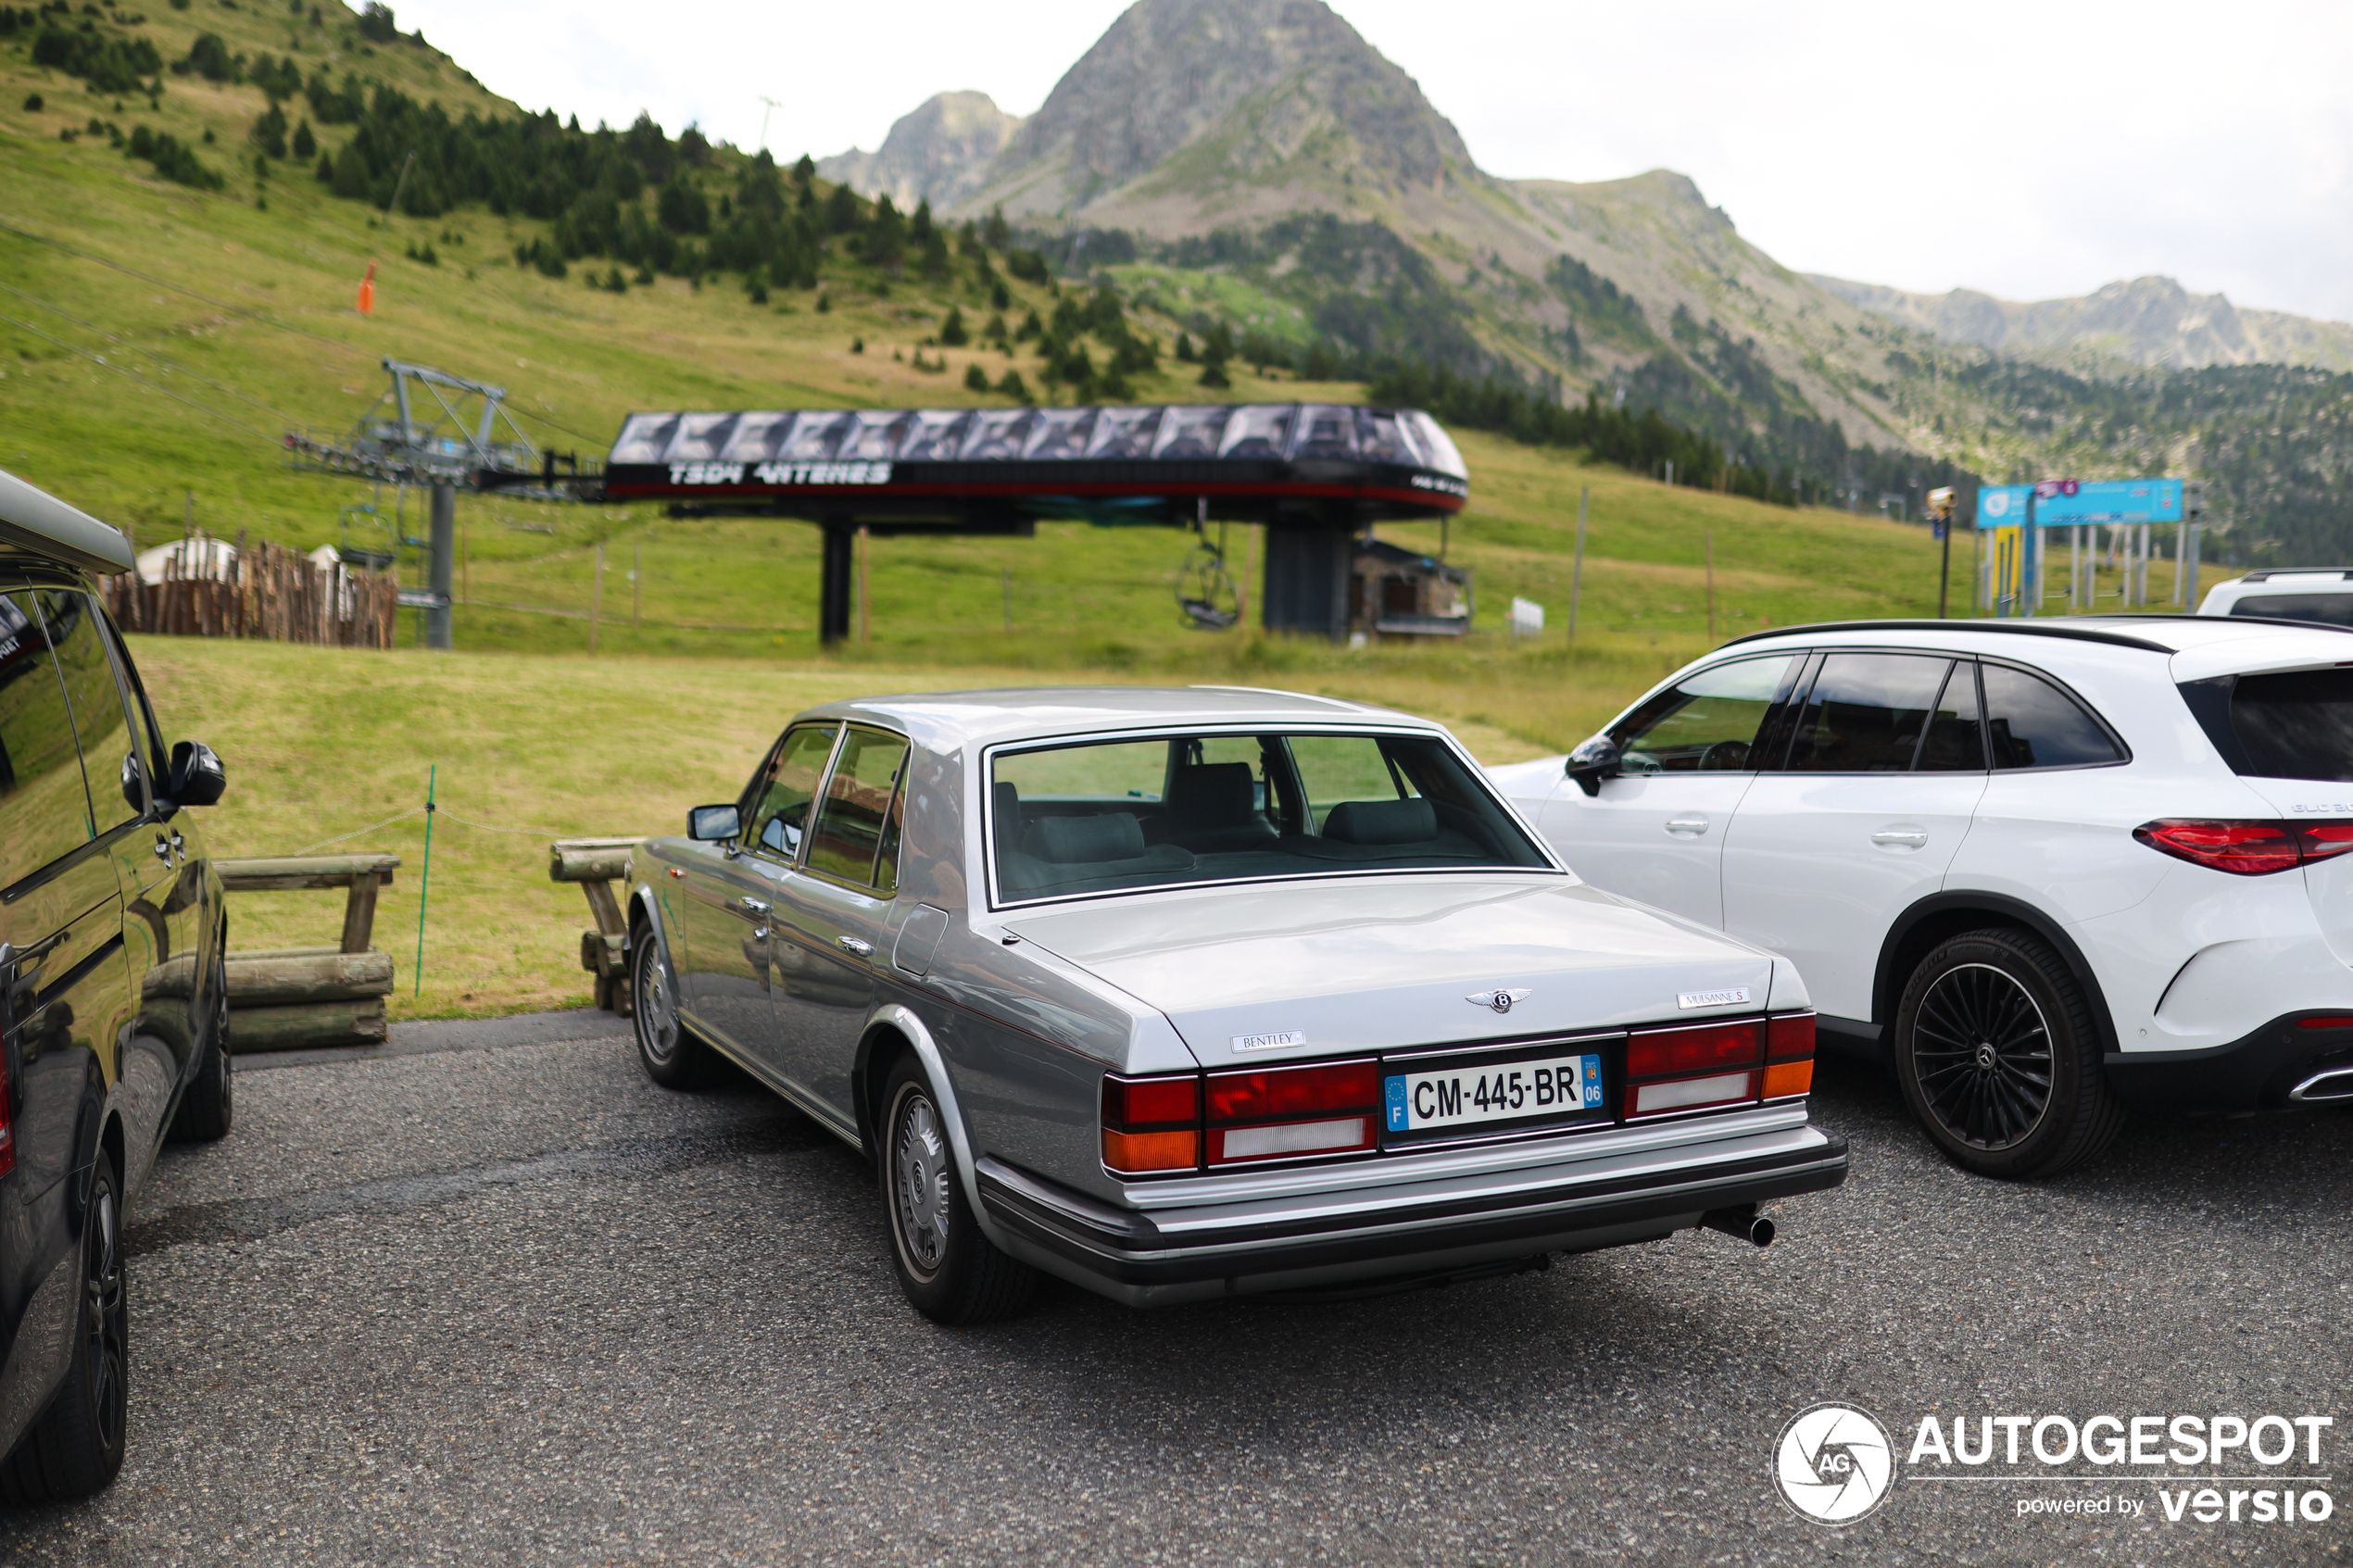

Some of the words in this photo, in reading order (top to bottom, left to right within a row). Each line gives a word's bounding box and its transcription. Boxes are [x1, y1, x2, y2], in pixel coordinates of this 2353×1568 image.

[2291, 803, 2330, 813] GLC
[1907, 950, 1945, 998] MICHELIN
[1498, 994, 1509, 1006] B
[1686, 992, 1732, 1005] MULSANNE
[1736, 991, 1743, 1001] S
[1243, 1033, 1292, 1047] BENTLEY
[1414, 1066, 1578, 1120] CM-445-BR
[1585, 1085, 1601, 1102] 06
[1392, 1106, 1402, 1123] F
